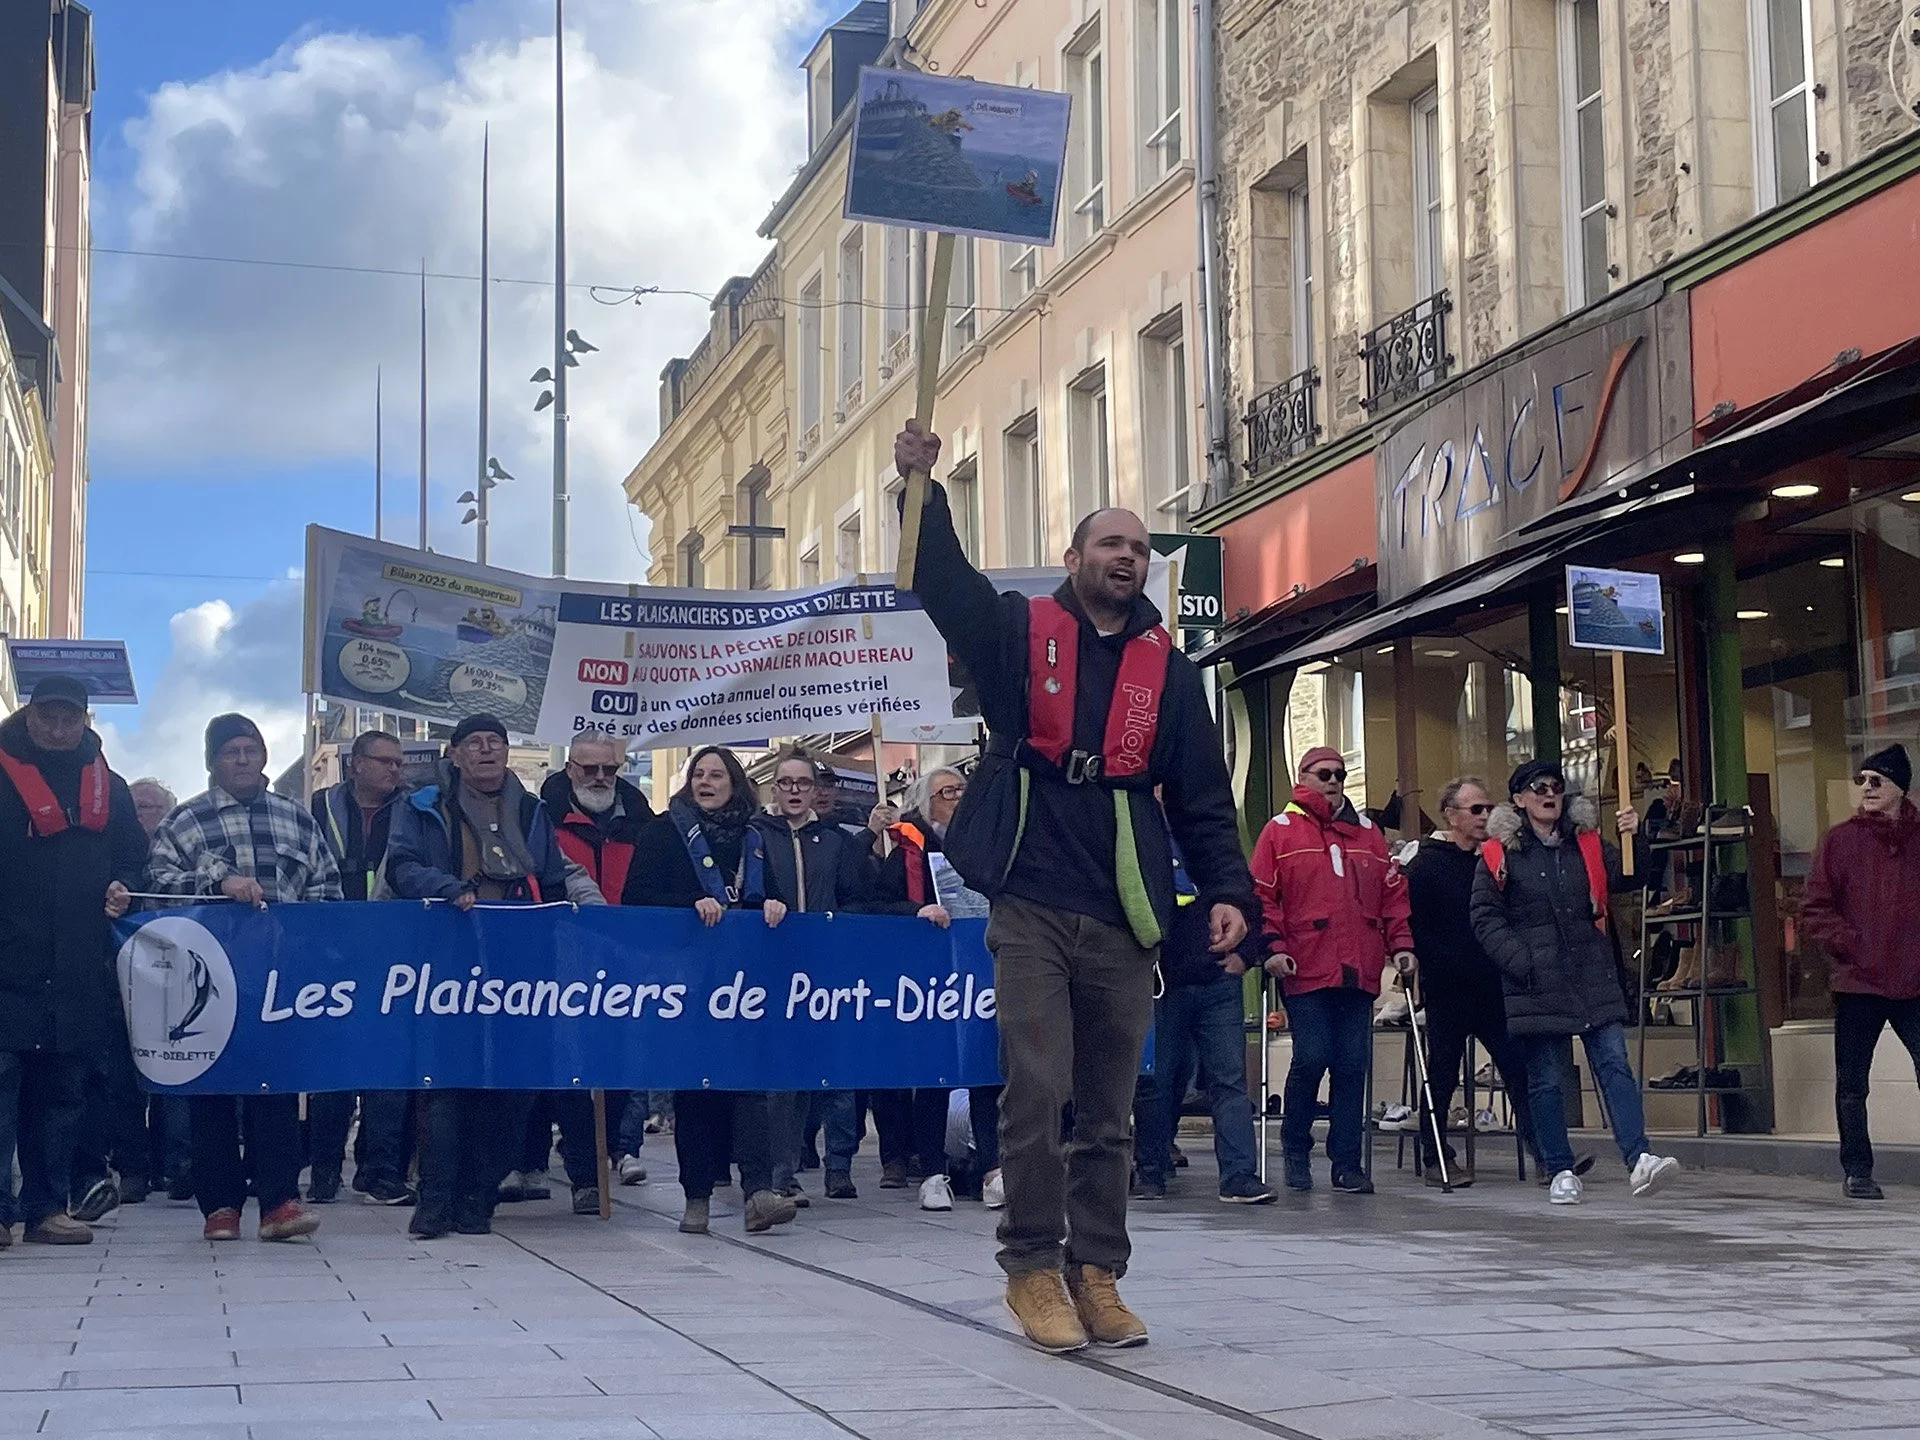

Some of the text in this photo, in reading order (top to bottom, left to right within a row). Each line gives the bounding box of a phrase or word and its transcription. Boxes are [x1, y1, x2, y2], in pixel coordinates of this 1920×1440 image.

[389, 565, 517, 603] Bilan 2025 du maquereau
[600, 590, 896, 626] LES PLAISANCIERS DE PORT DIELETTE
[639, 628, 858, 659] SAUVONS LA PÊCHE DE LOISIR
[583, 647, 914, 684] NON AU QUOTA JOURNALIER MAQUEREAU
[600, 675, 888, 713] OUI à un quota annuel ou semestriel
[622, 723, 642, 736] sur
[647, 719, 677, 734] des
[681, 711, 742, 732] données
[746, 704, 842, 723] scientifiques
[847, 697, 921, 714] vérifiées
[1118, 683, 1158, 768] pilot
[260, 969, 356, 1022] Les
[380, 963, 687, 1019] Plaisanciers
[708, 970, 767, 1020] de
